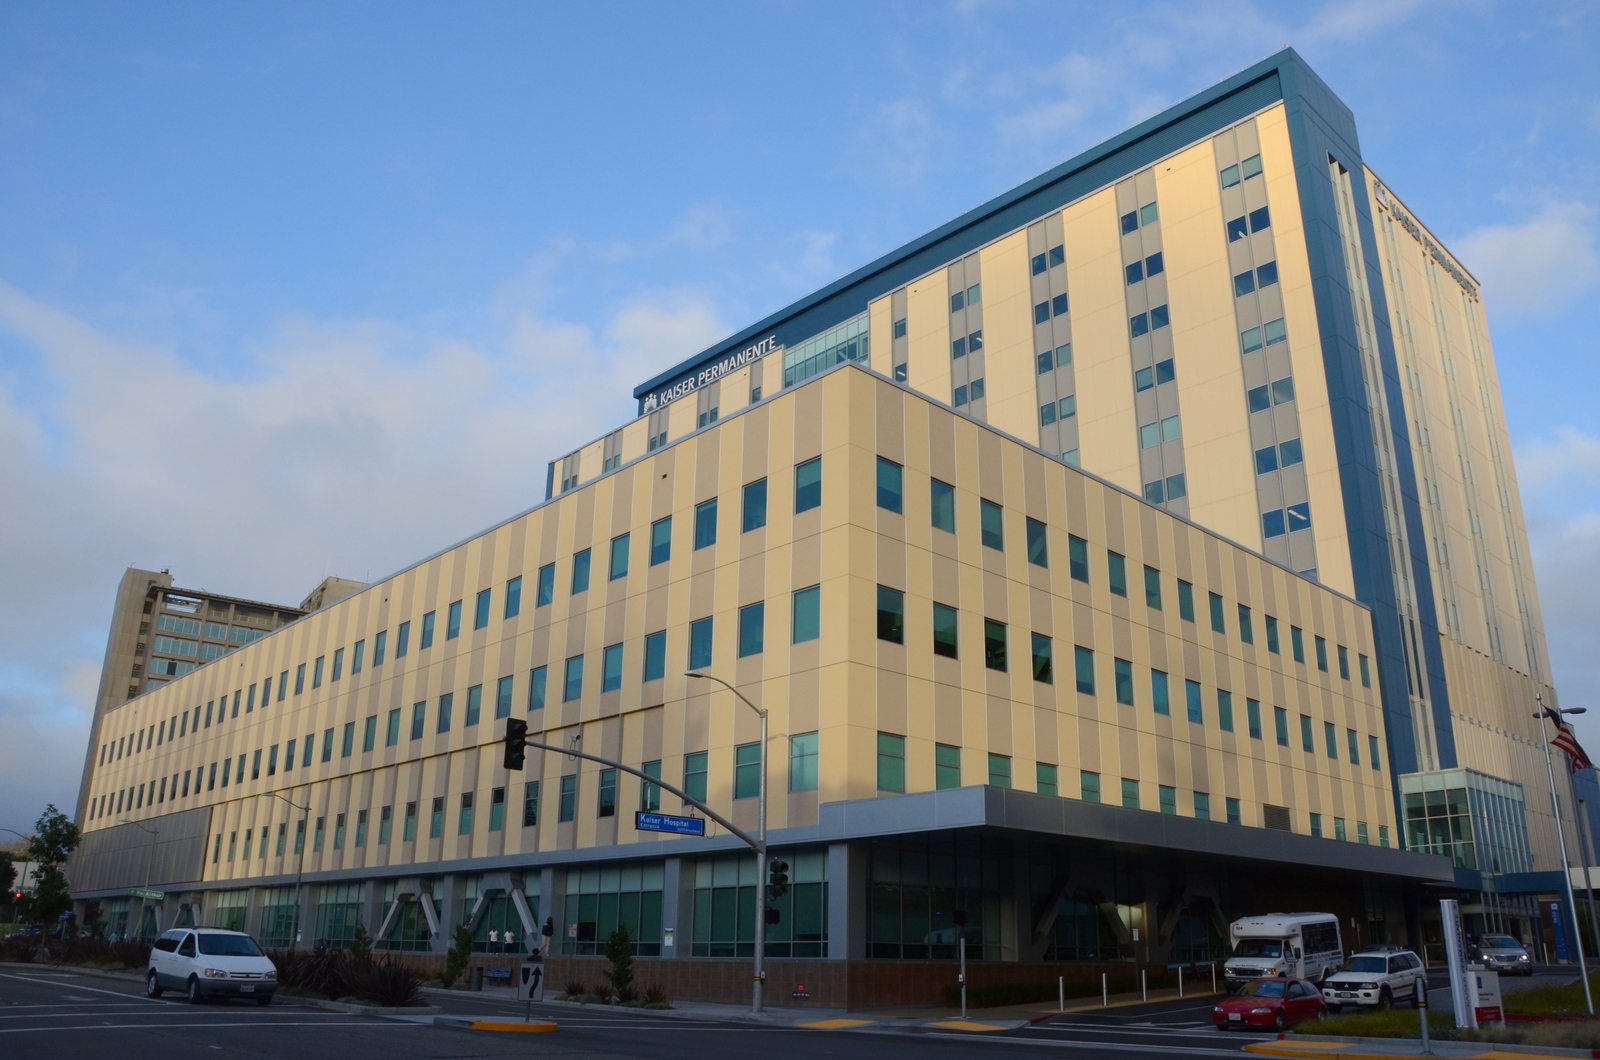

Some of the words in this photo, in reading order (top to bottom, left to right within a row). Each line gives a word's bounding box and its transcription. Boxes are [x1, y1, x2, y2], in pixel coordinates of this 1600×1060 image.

[660, 377, 695, 405] KAISER
[698, 334, 776, 385] PERMANENTE
[640, 814, 661, 824] Kaiser
[663, 816, 689, 827] Hospital
